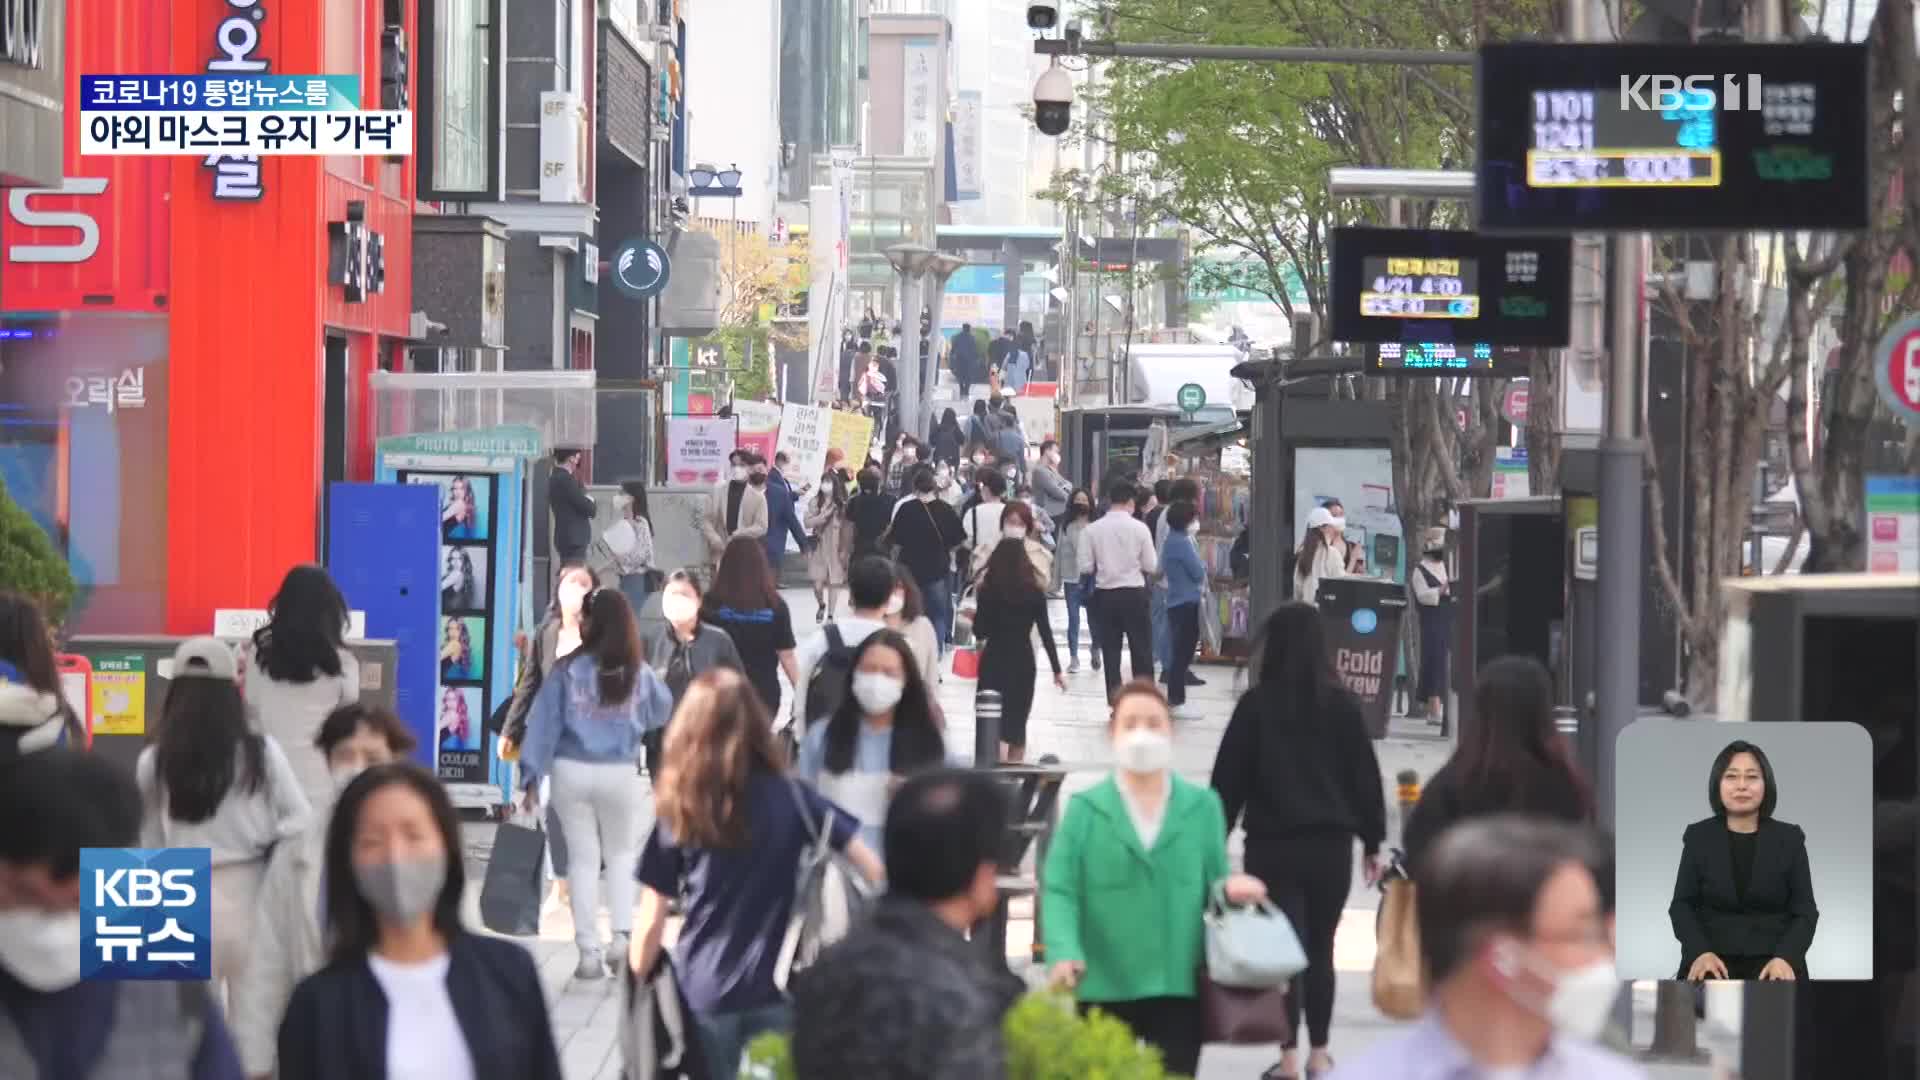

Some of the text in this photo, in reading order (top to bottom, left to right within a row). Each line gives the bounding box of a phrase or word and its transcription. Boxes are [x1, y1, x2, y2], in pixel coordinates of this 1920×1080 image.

[698, 347, 718, 366] kt
[64, 366, 146, 415] 오락실
[1335, 647, 1383, 674] Cold
